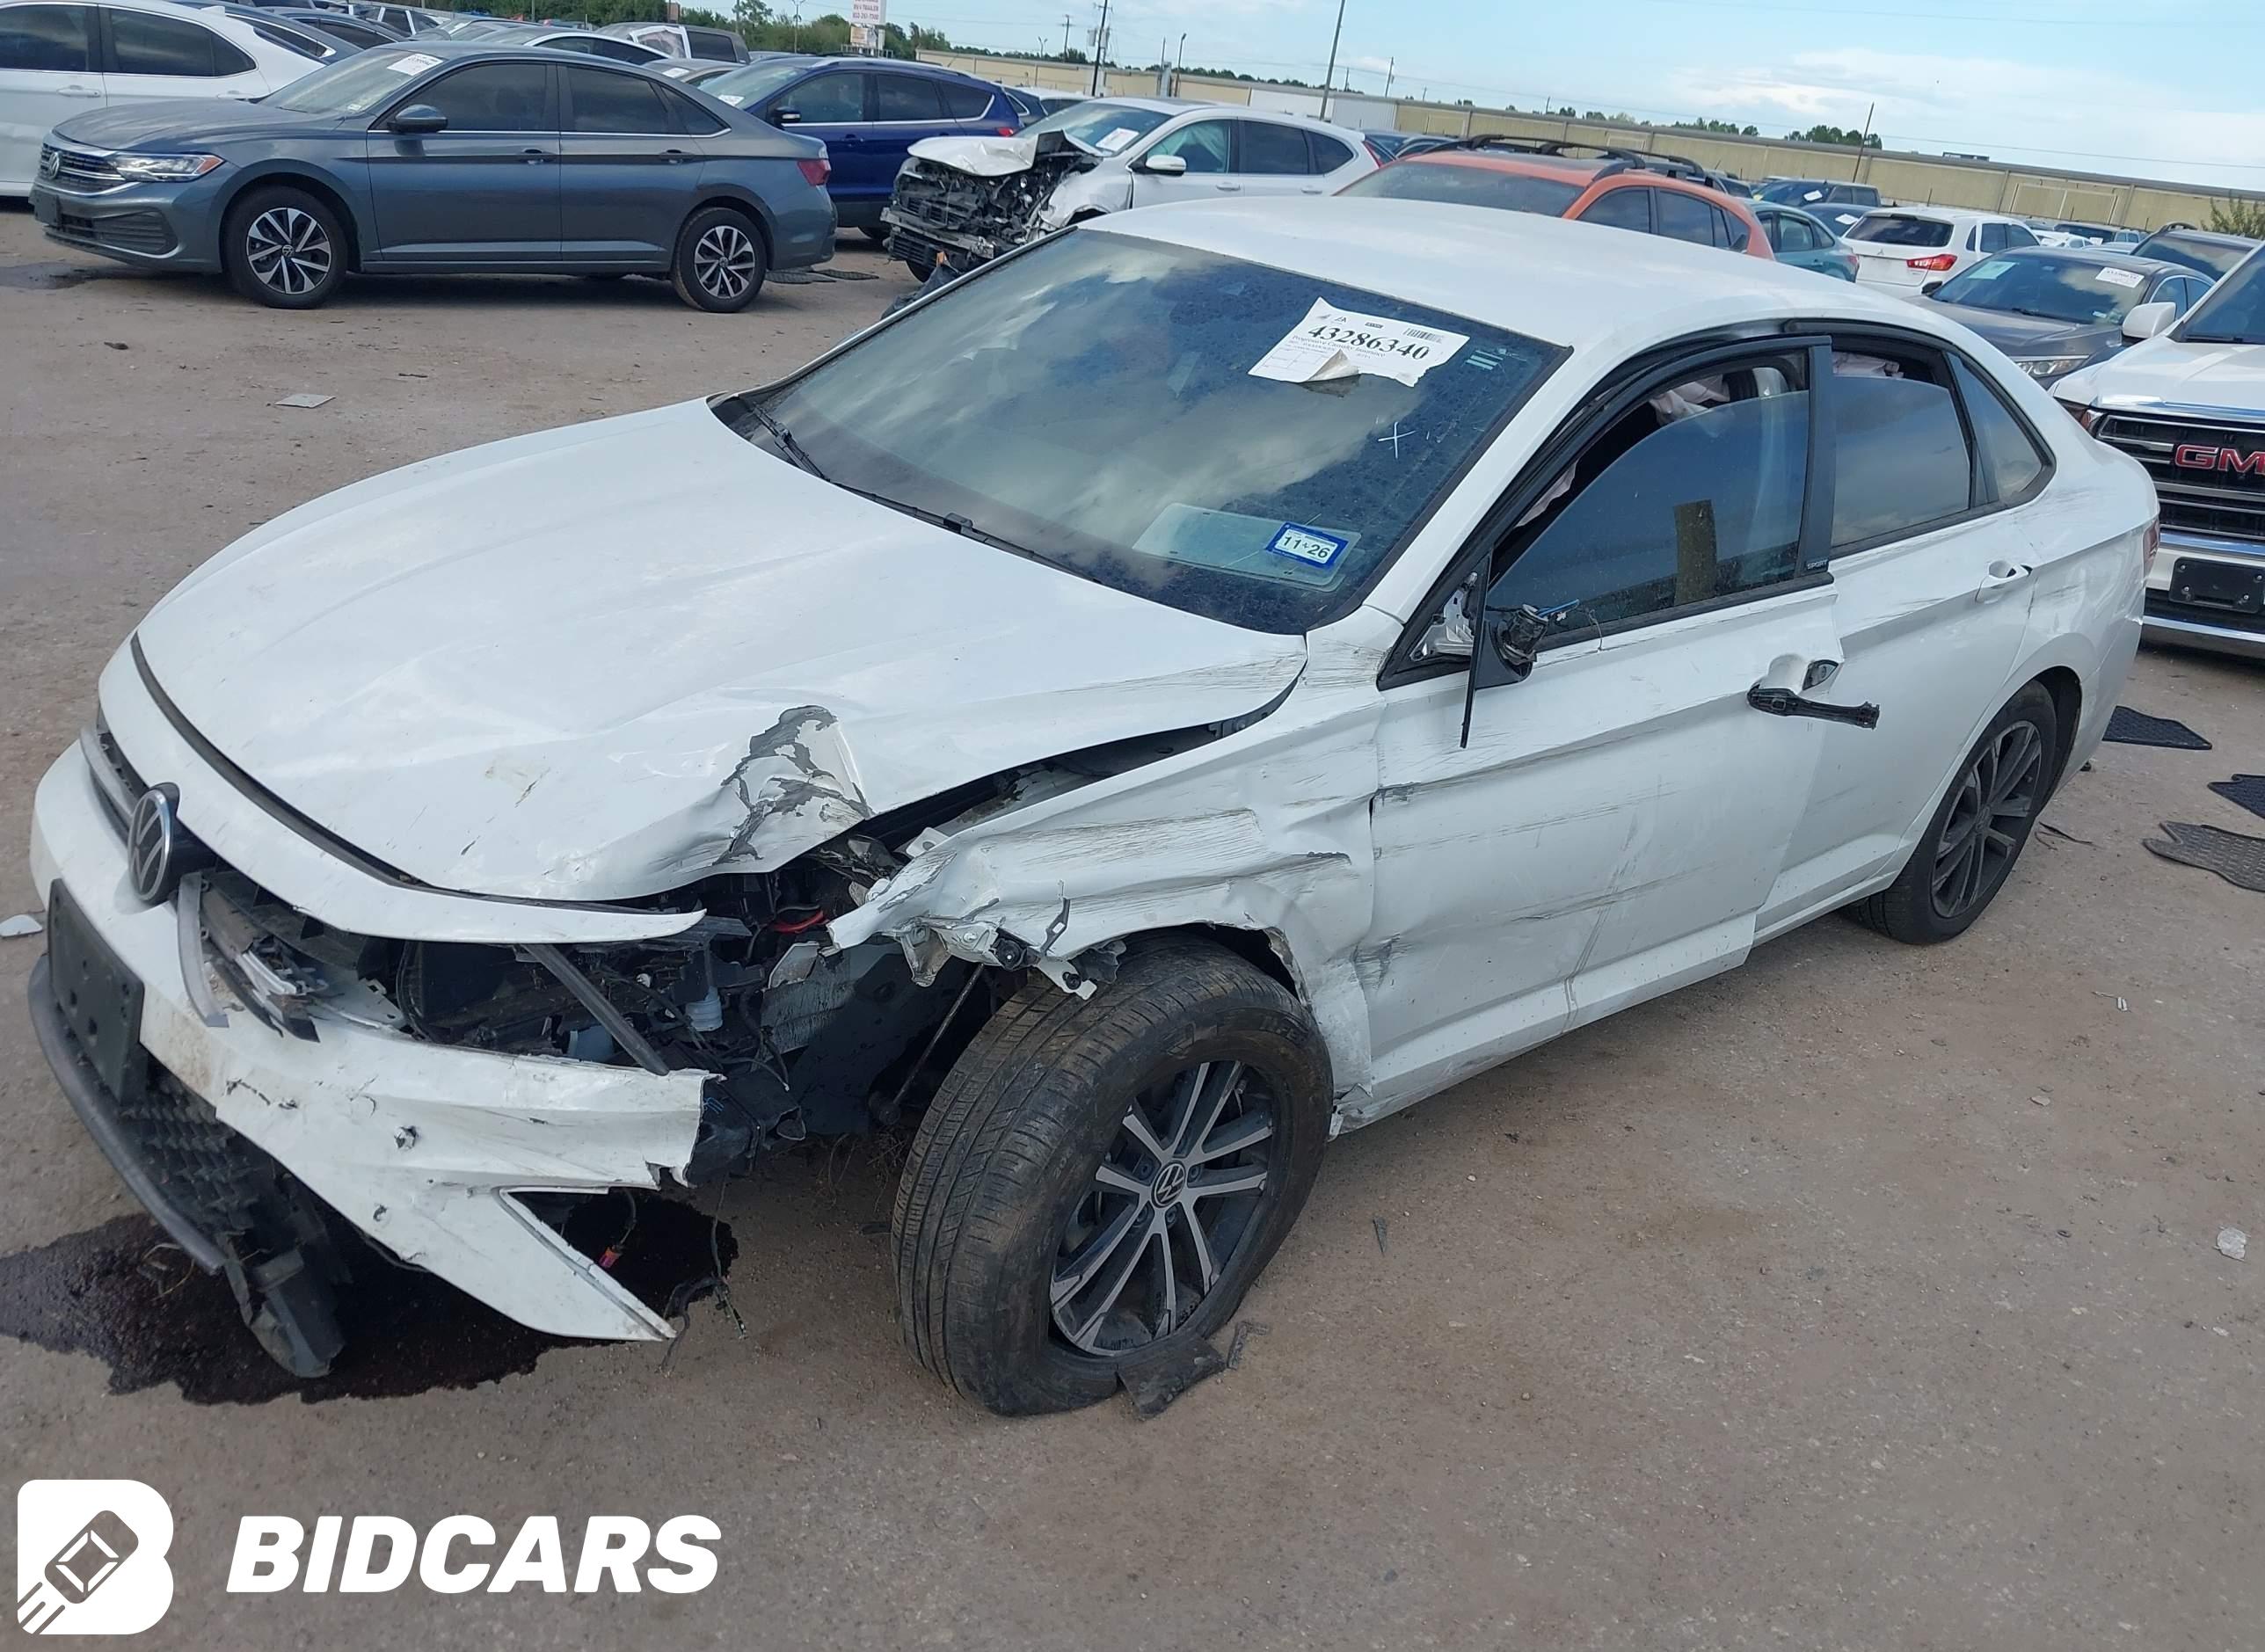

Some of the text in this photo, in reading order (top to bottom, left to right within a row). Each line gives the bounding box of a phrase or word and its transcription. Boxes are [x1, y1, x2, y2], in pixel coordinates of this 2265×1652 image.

[1308, 325, 1431, 360] 43286340
[1284, 536, 1301, 549] 11
[1307, 544, 1330, 558] 26
